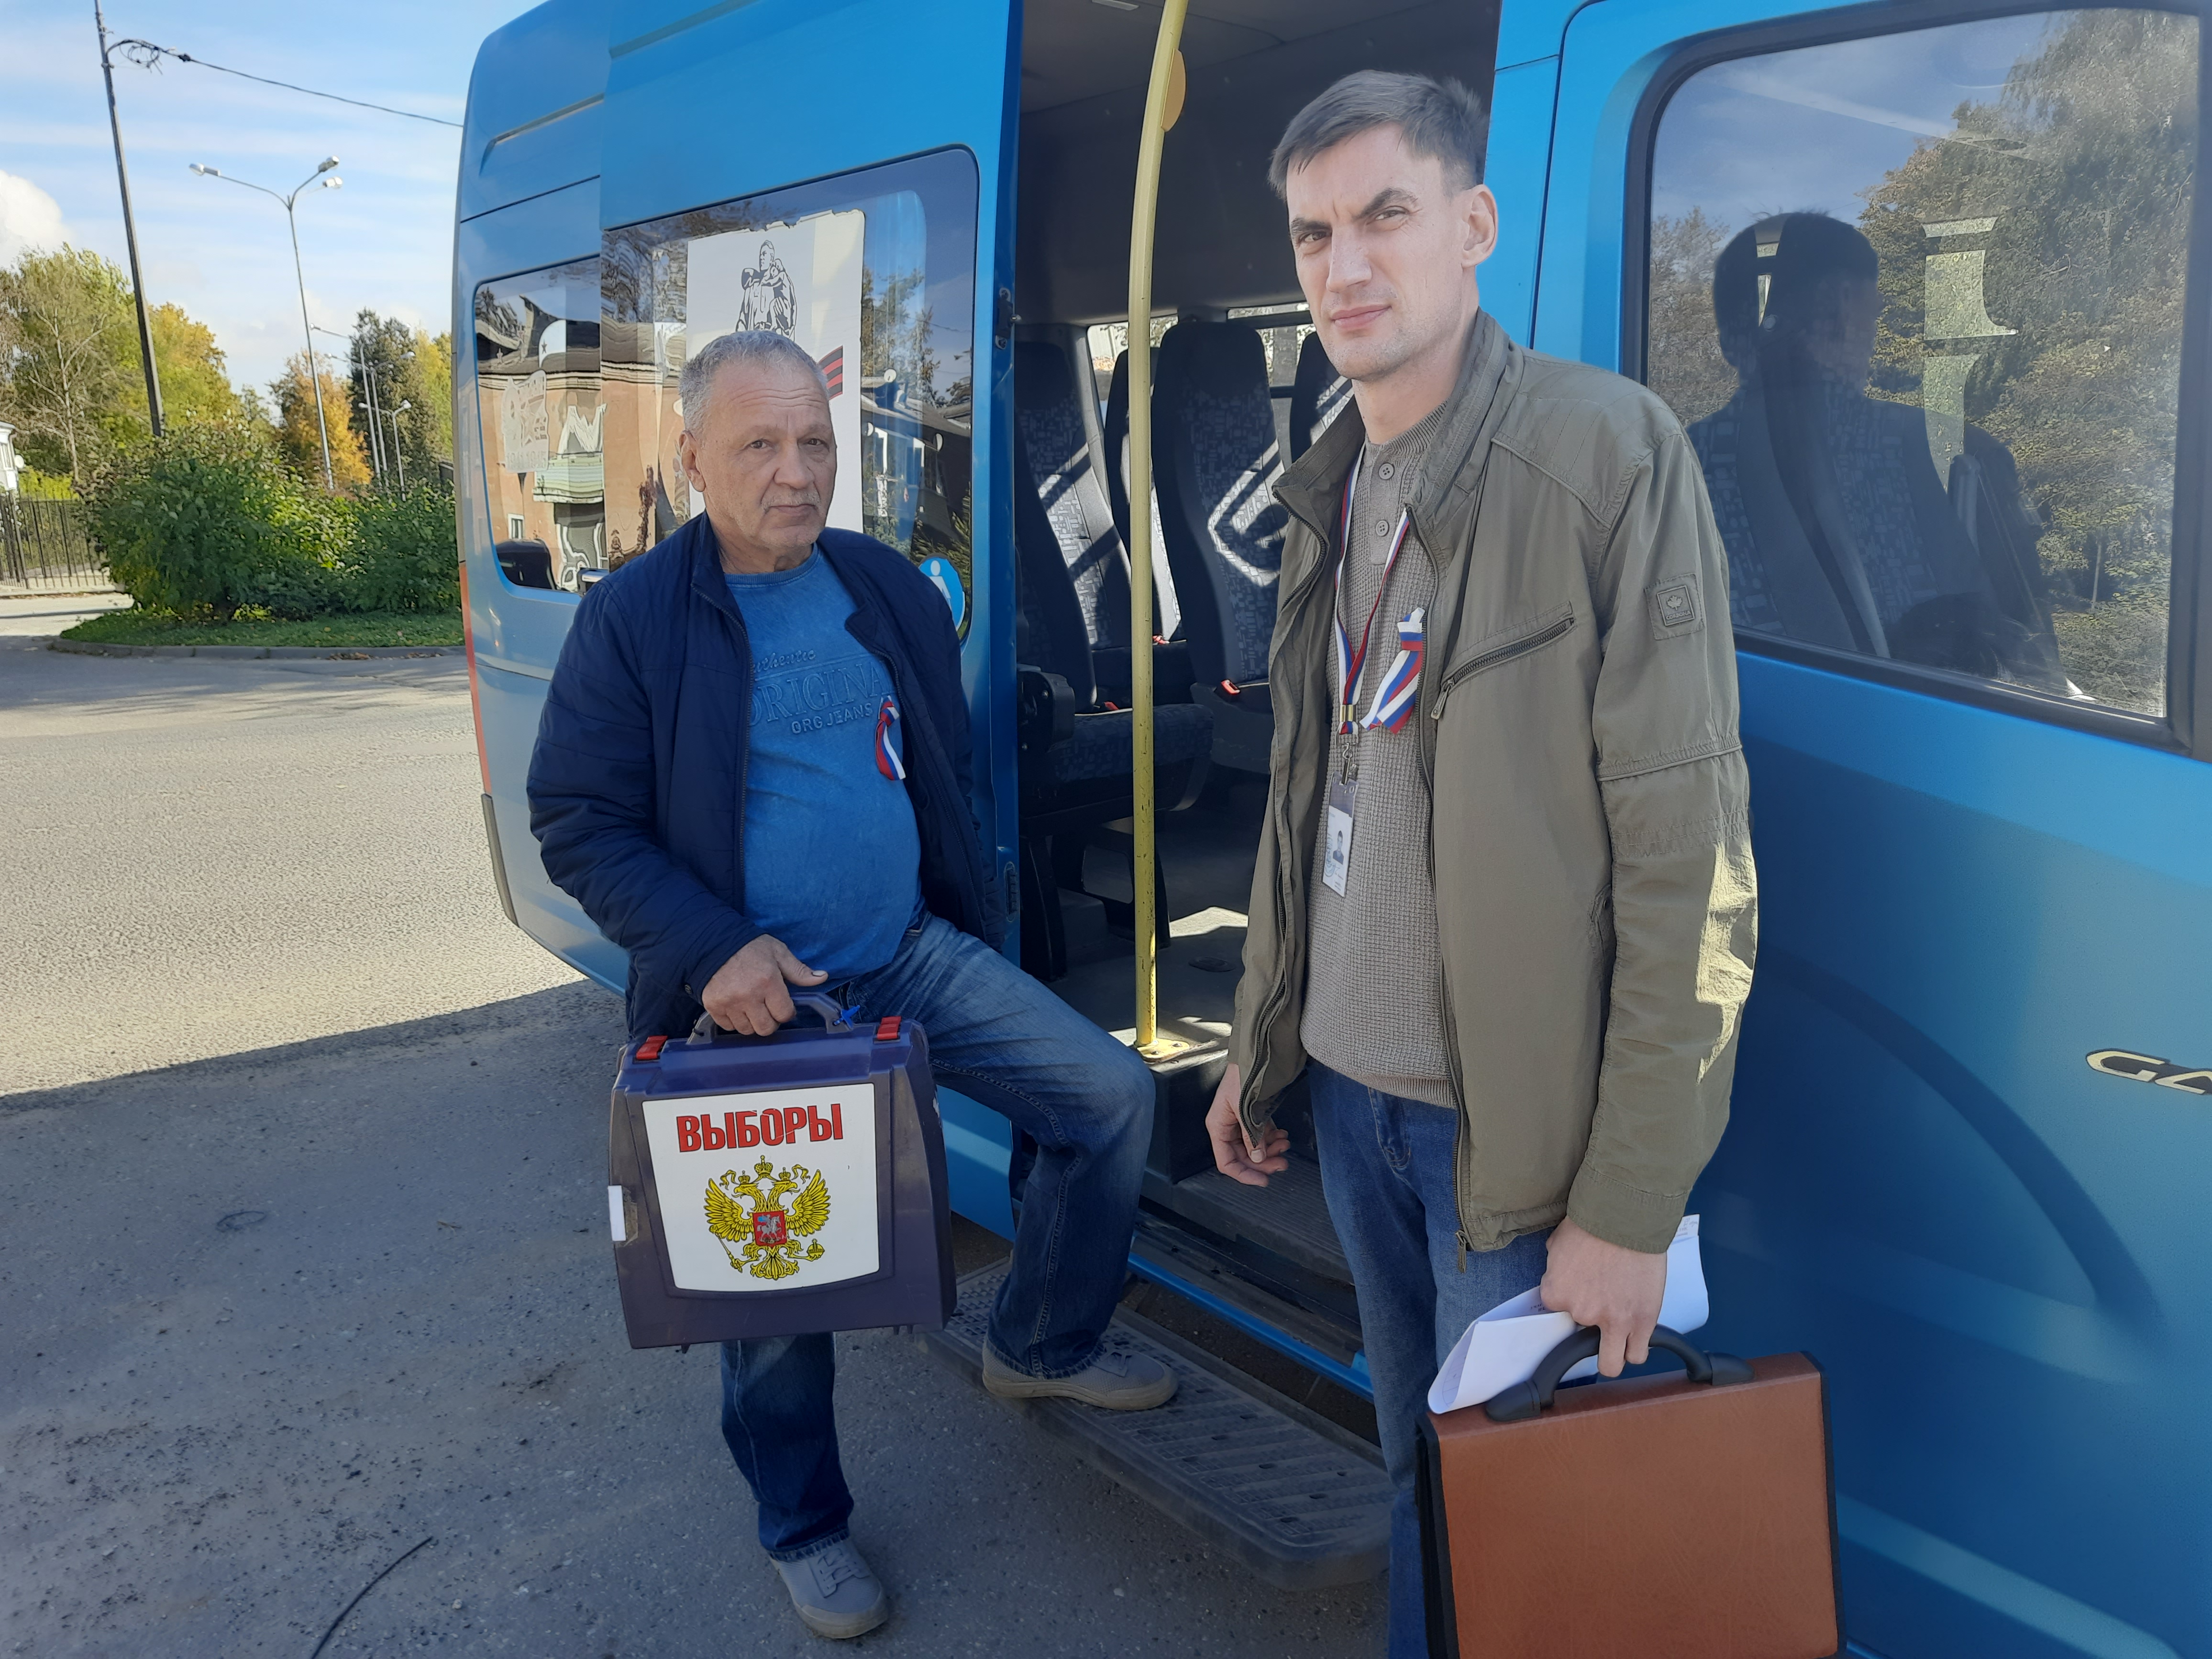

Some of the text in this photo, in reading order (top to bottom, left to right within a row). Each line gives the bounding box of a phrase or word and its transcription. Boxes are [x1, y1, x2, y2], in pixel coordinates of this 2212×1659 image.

[753, 649, 816, 673] uthentic
[791, 702, 874, 734] ORG JEANS
[676, 1103, 843, 1153] ВЫБОРЫ
